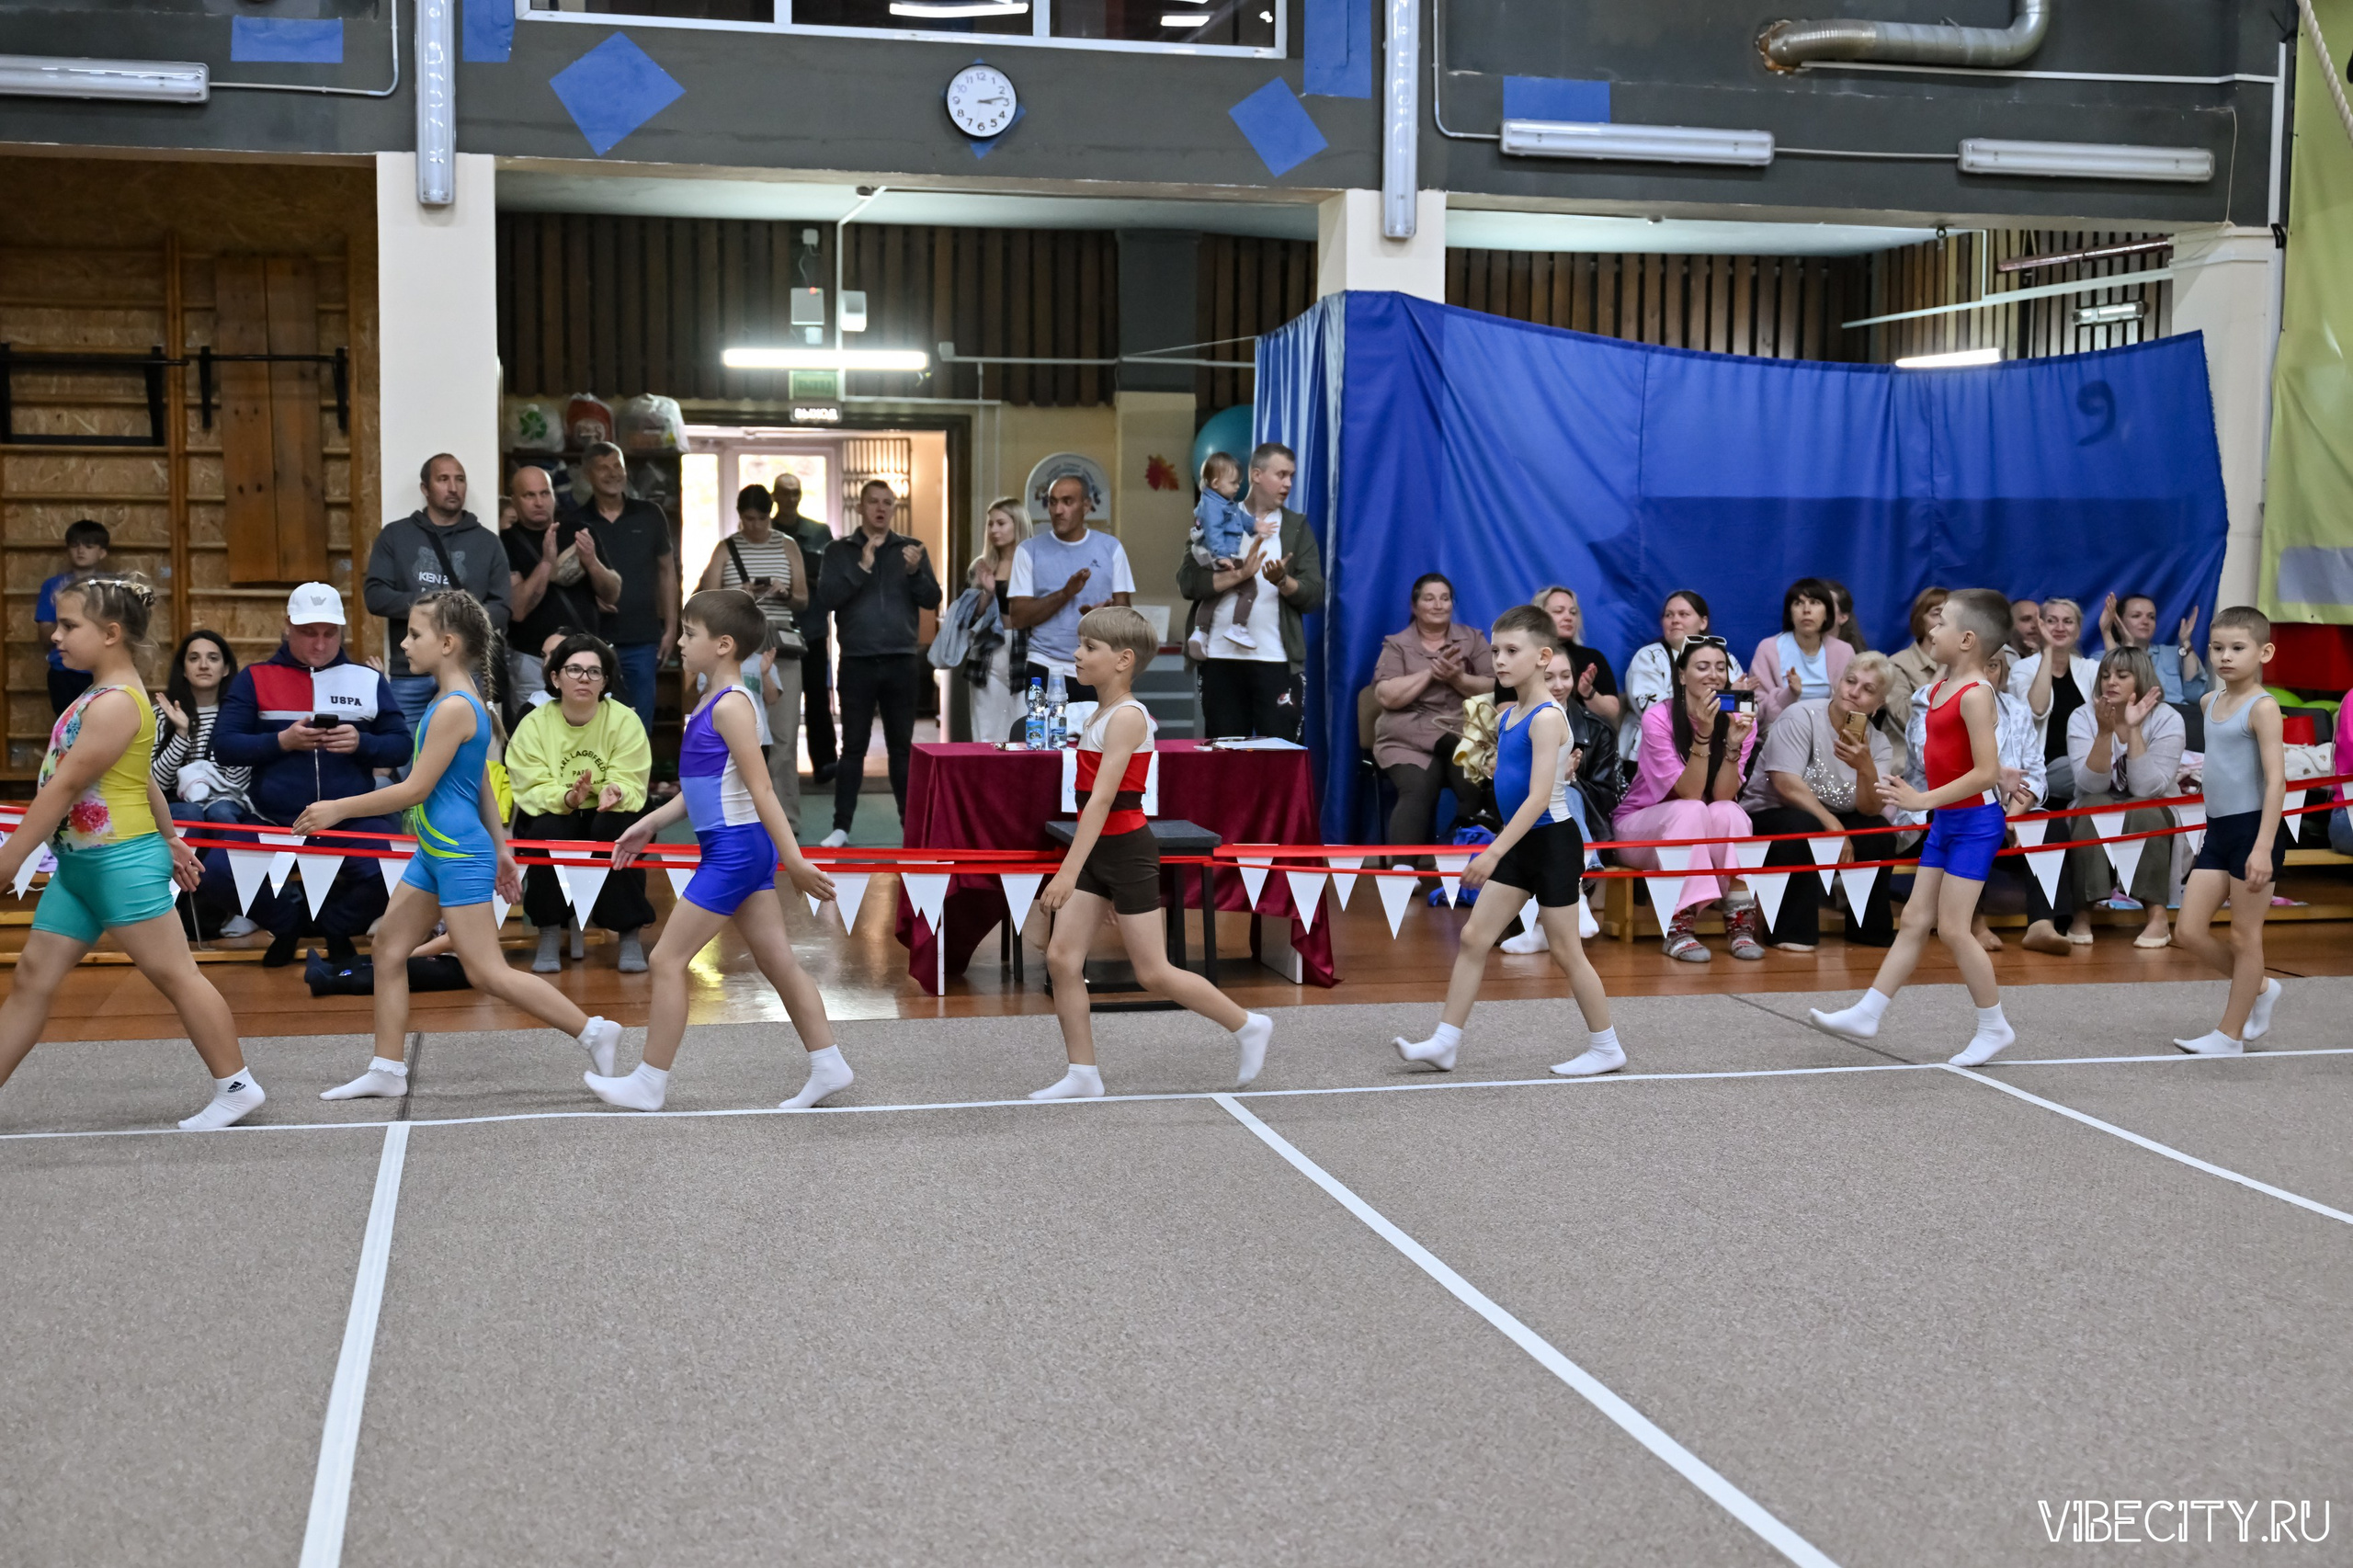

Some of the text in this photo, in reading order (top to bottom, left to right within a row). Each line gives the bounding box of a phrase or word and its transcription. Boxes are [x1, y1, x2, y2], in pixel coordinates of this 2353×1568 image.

[965, 75, 973, 84] 11
[976, 72, 986, 81] 12
[998, 85, 1006, 95] 2
[952, 96, 961, 105] 9
[1003, 97, 1009, 107] 3
[957, 108, 964, 118] 8
[998, 110, 1006, 119] 4
[966, 118, 972, 127] 7
[977, 122, 985, 131] 6
[990, 118, 997, 128] 5
[330, 696, 362, 706] USPA
